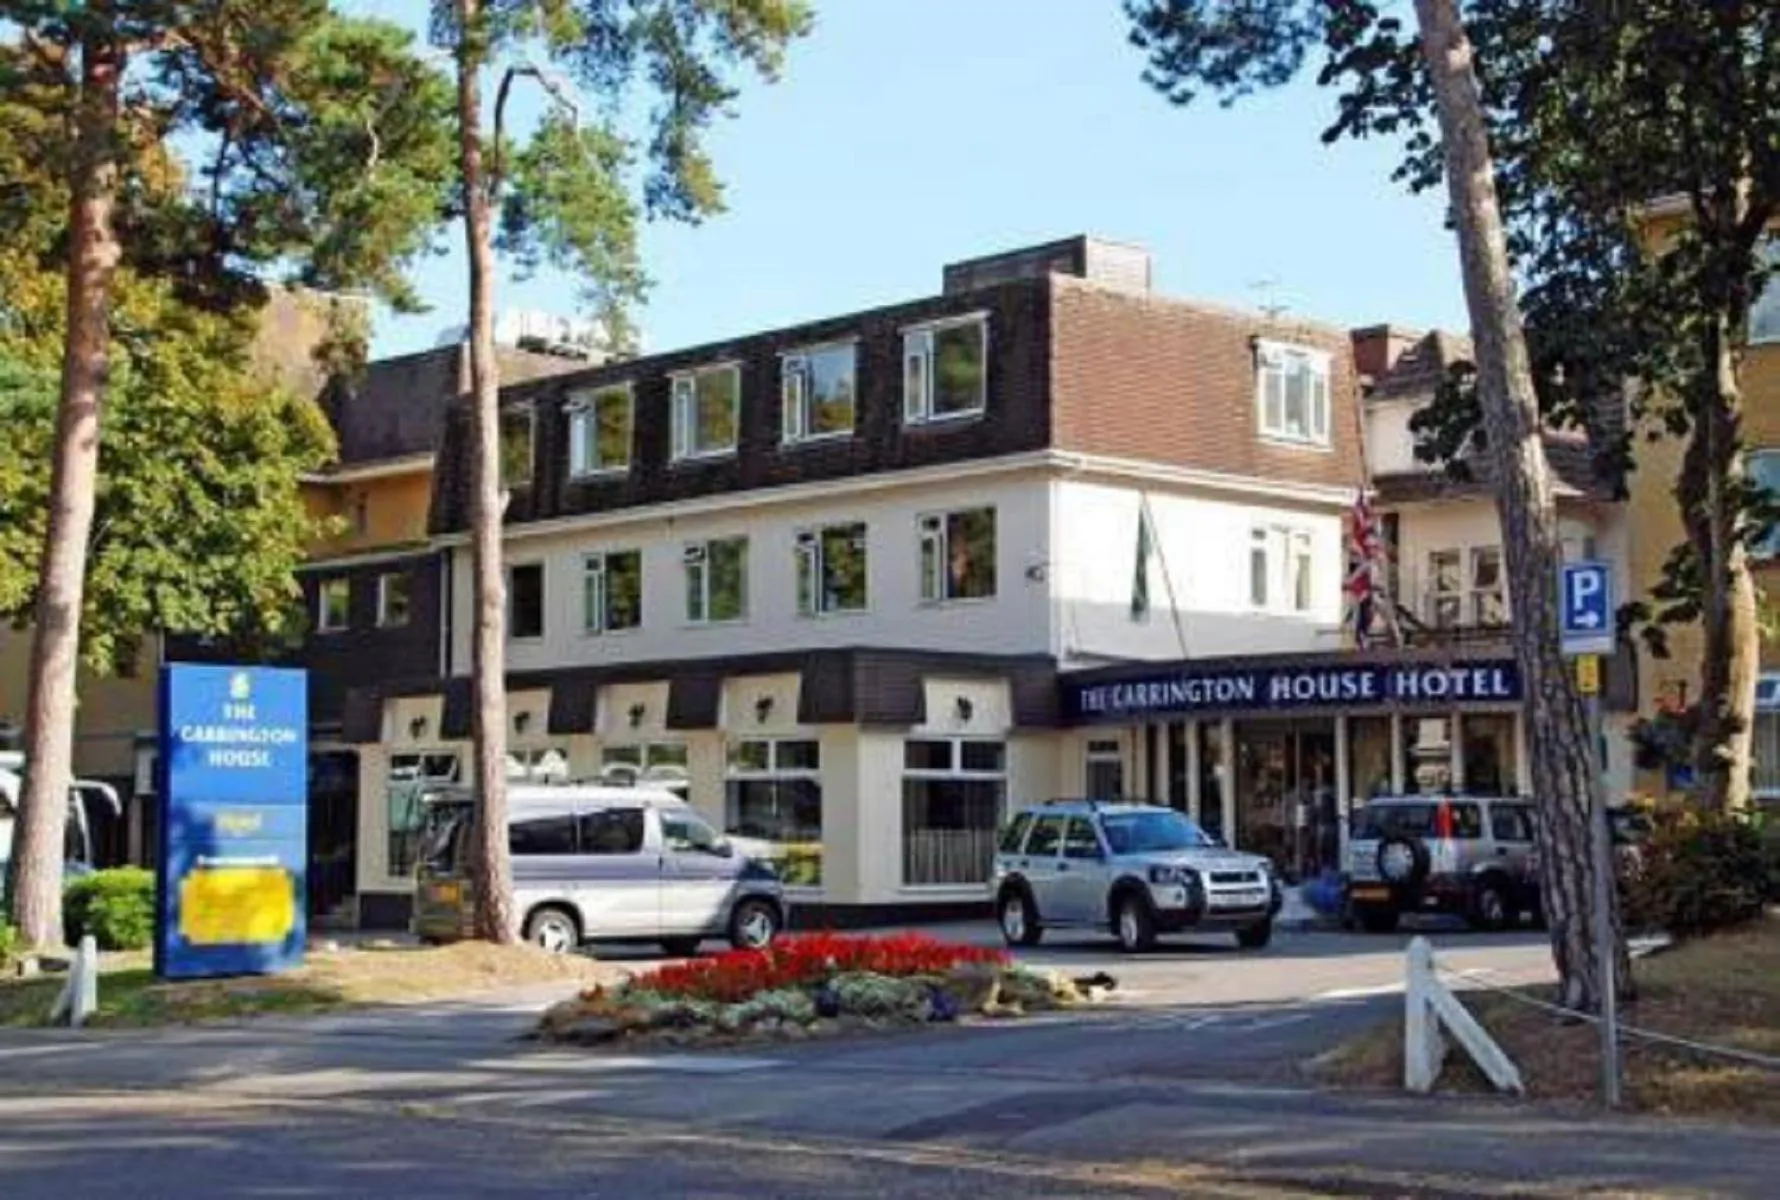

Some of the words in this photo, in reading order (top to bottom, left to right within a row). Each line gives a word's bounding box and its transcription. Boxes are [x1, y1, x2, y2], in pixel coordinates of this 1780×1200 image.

[1573, 569, 1600, 610] P
[1080, 686, 1107, 711] THE
[1112, 676, 1255, 708] CARRINGTON
[1270, 671, 1376, 700] HOUSE
[1396, 667, 1510, 696] HOTEL
[222, 703, 256, 720] THE
[209, 751, 271, 768] HOUSE
